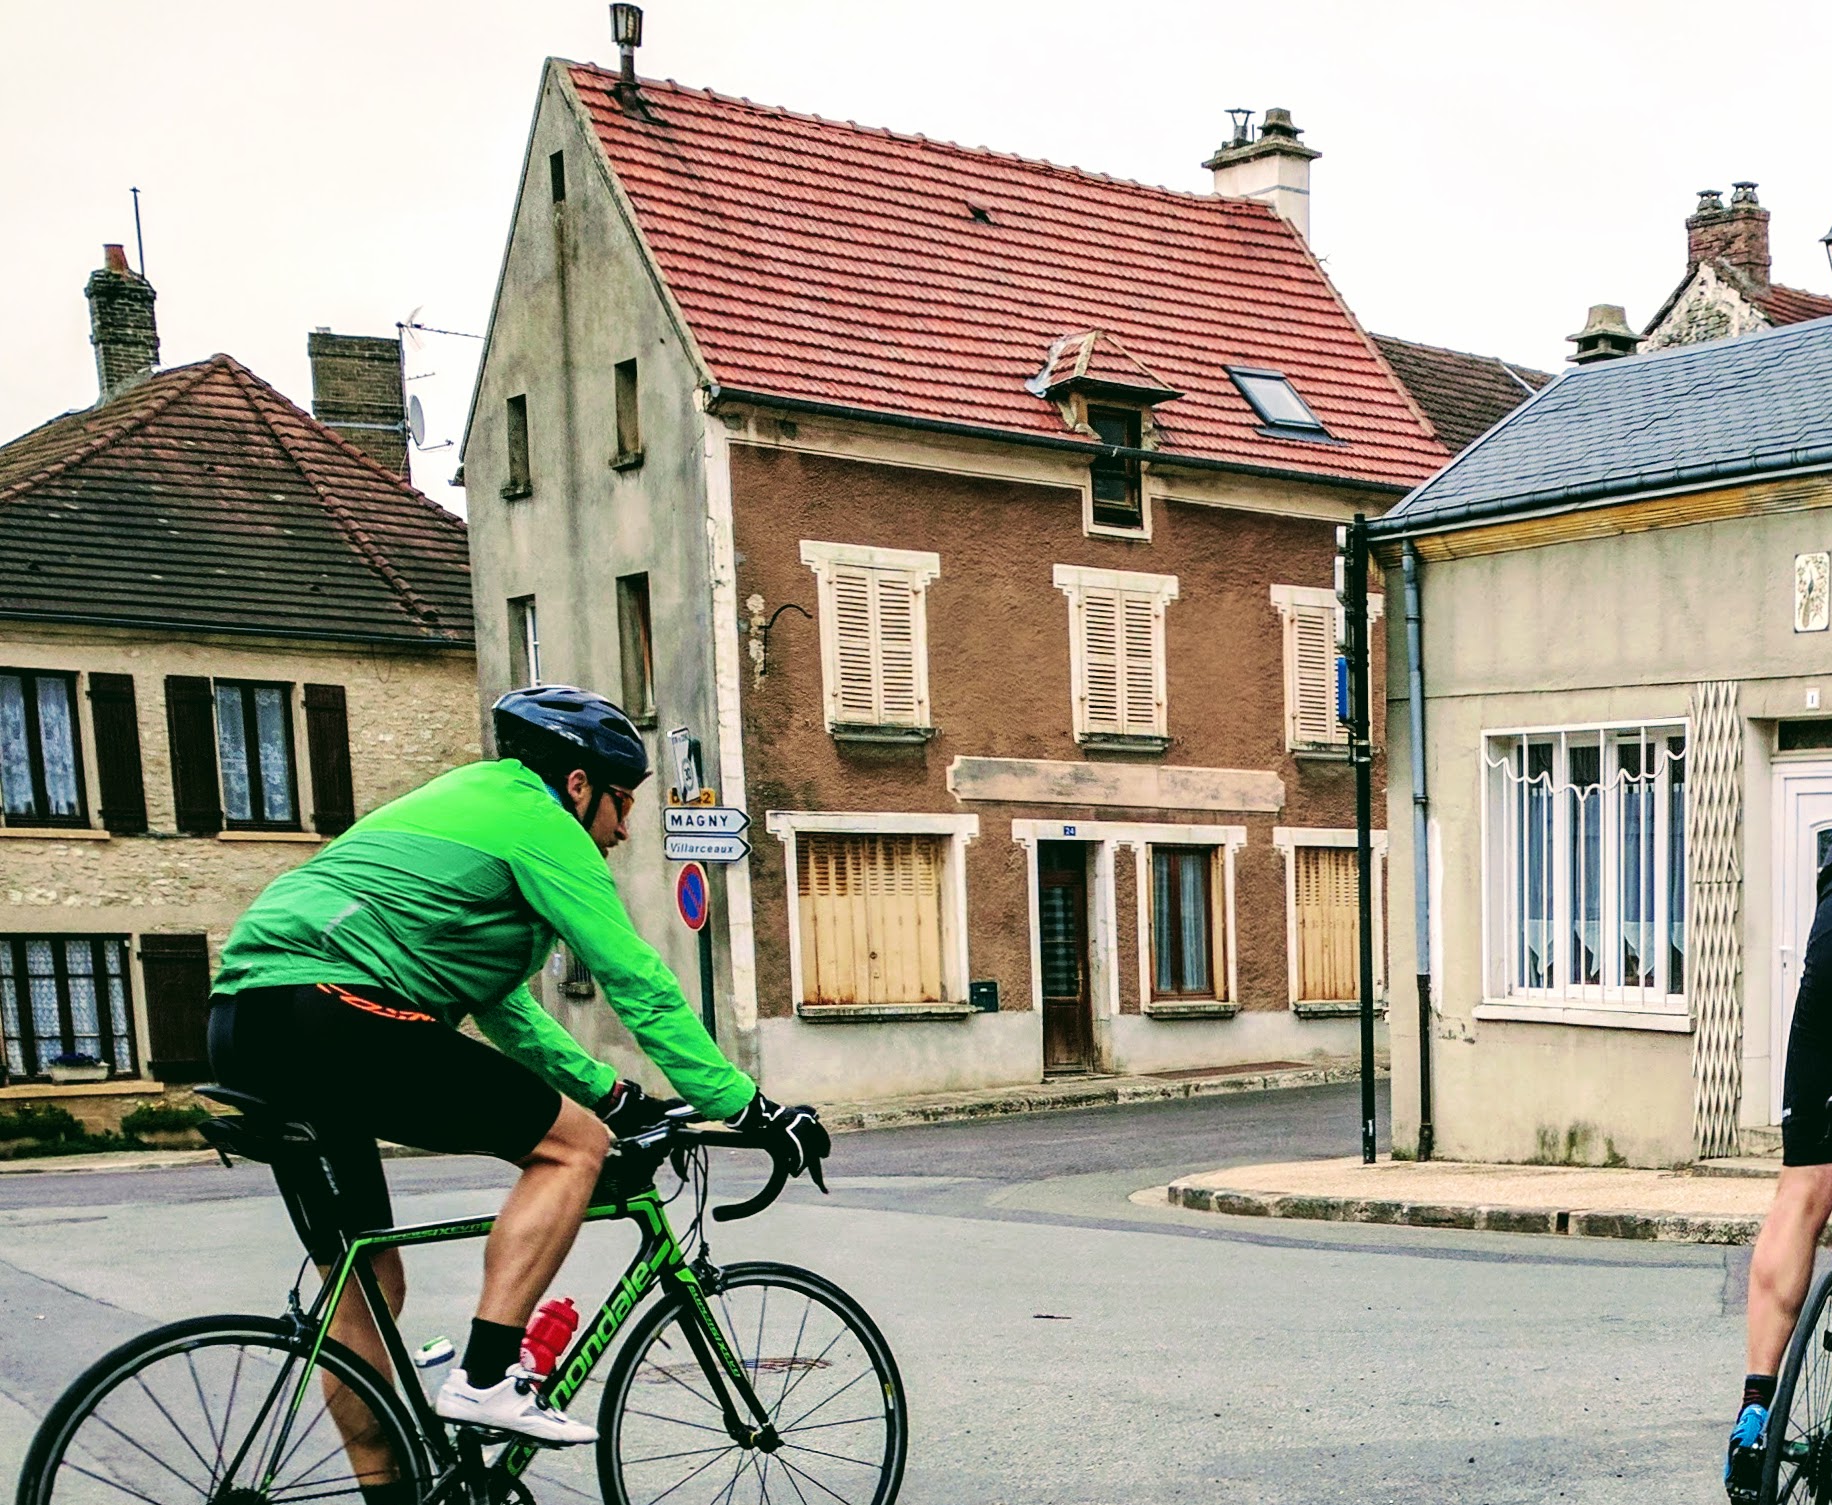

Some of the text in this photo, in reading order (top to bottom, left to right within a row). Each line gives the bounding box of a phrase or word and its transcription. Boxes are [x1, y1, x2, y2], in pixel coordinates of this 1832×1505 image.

[671, 815, 728, 827] MAGNY
[1065, 827, 1075, 835] 24
[670, 842, 734, 854] Villarceaux
